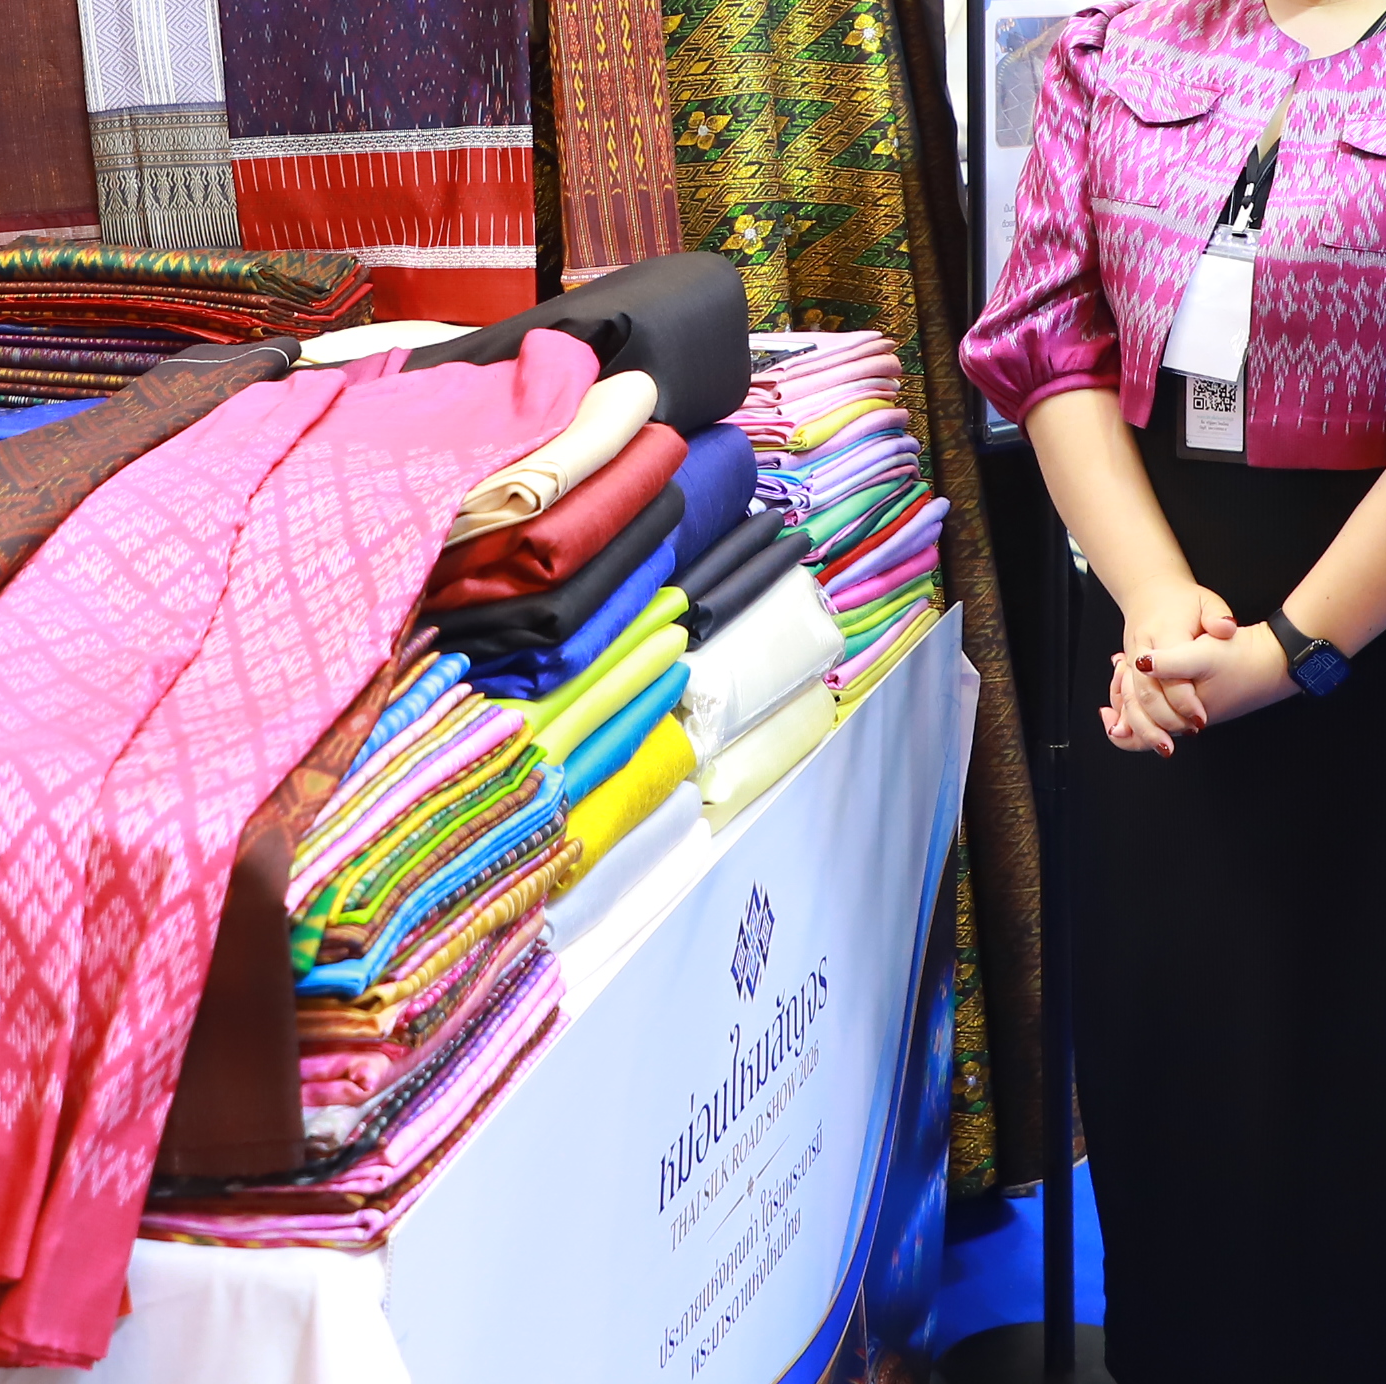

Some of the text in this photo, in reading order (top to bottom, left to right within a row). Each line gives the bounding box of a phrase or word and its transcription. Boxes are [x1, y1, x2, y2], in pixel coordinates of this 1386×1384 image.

[658, 956, 828, 1216] หม่อนไหมสัญจร
[670, 1039, 820, 1253] THAI SILK ROAD SHOW 2026
[659, 1213, 759, 1370] ประกายแห่งคุณค่า
